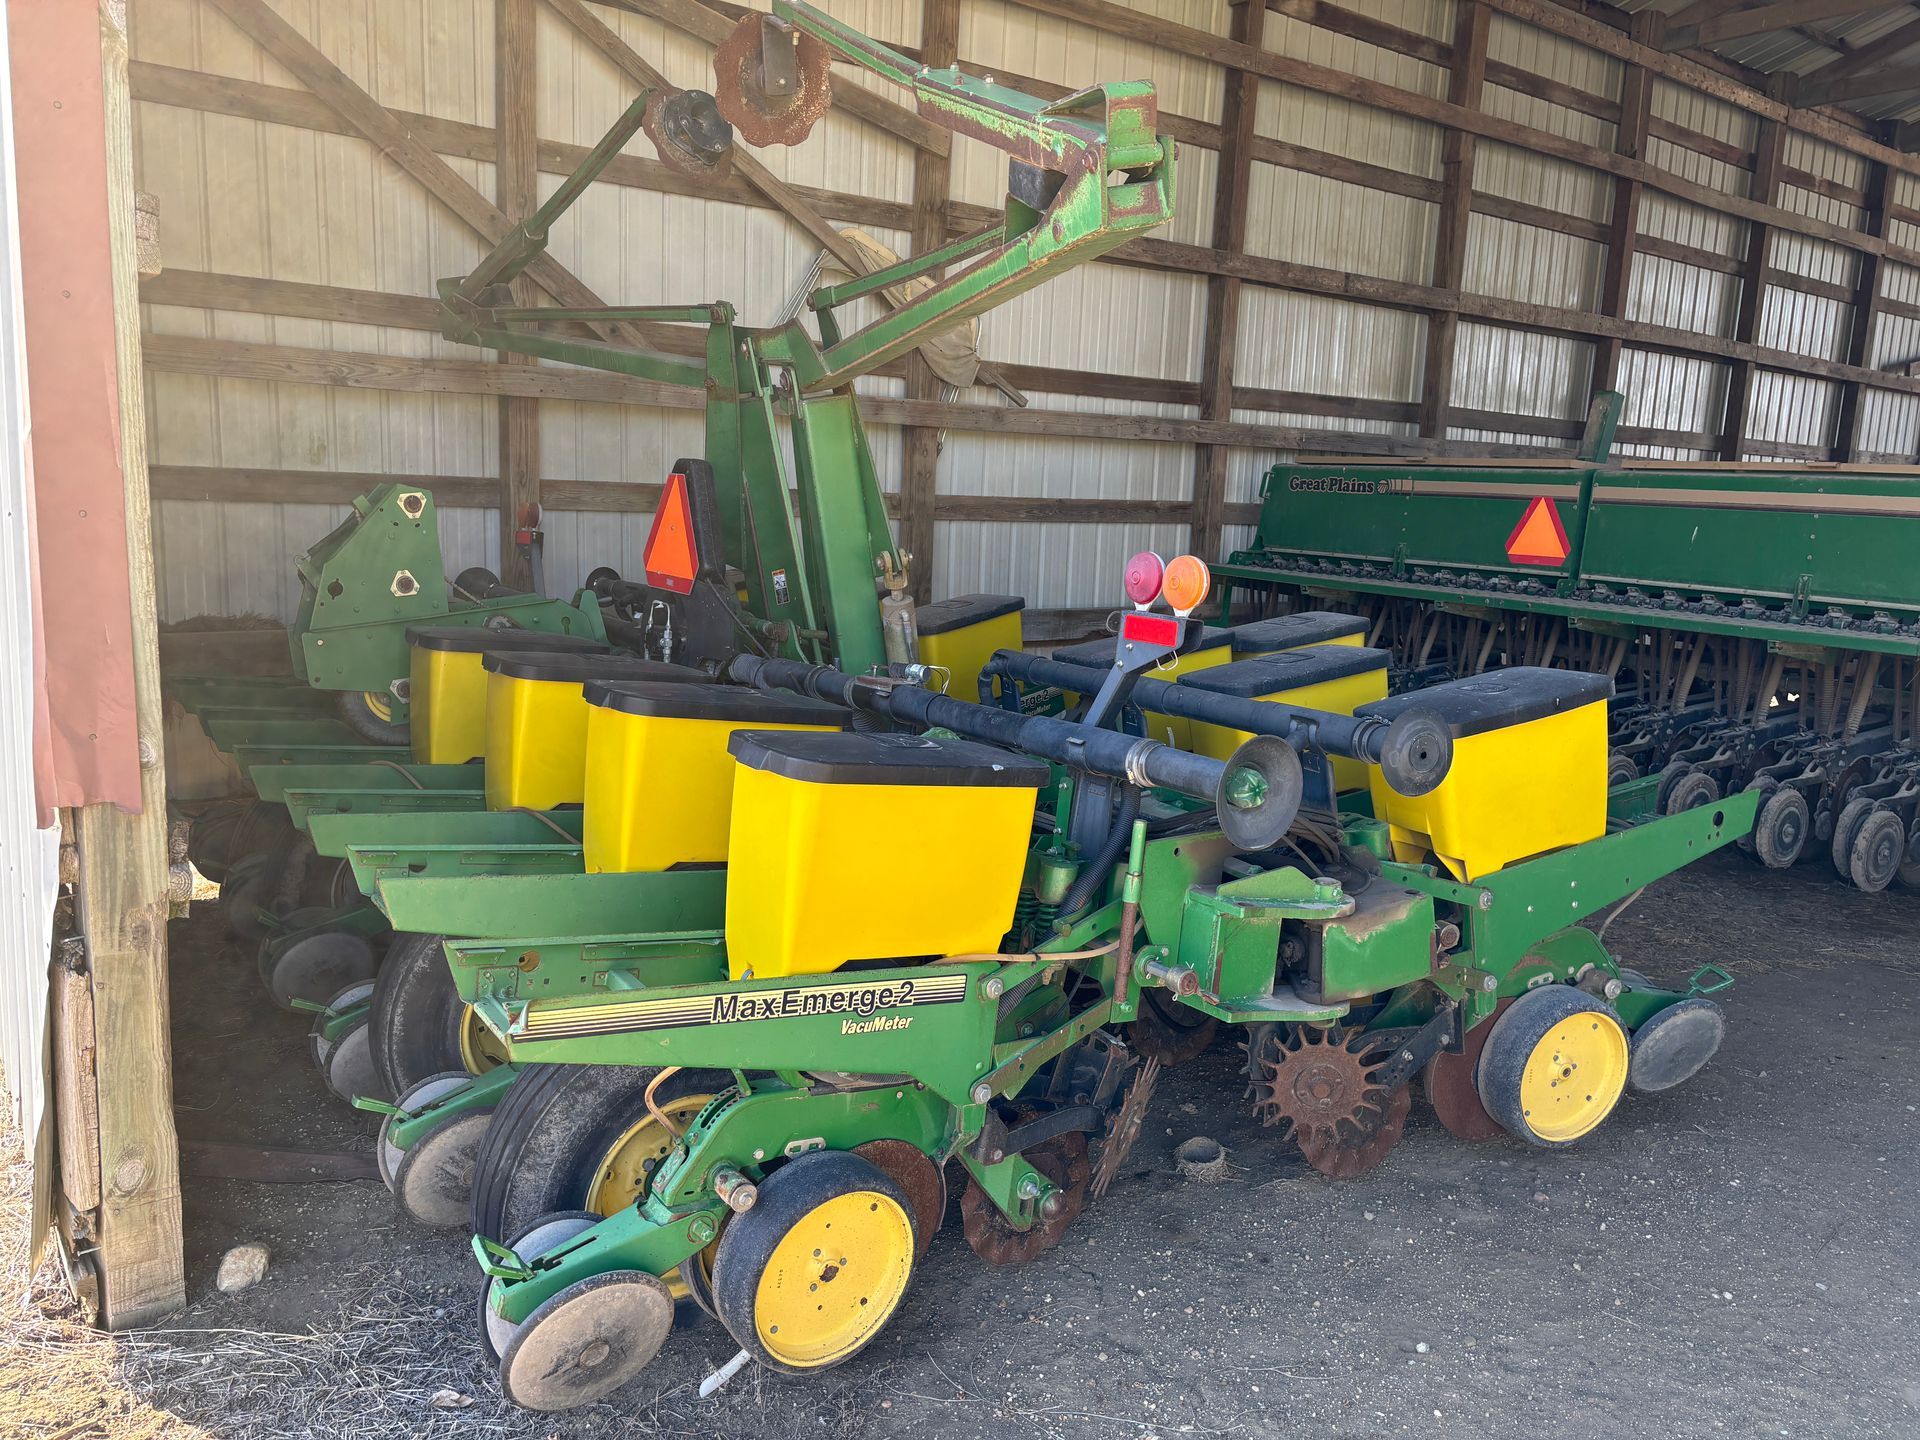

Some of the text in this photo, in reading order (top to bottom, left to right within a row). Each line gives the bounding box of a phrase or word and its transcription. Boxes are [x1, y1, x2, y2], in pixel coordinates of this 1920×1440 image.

[1289, 475, 1375, 495] Great Plains
[841, 1015, 913, 1035] VacuMeter
